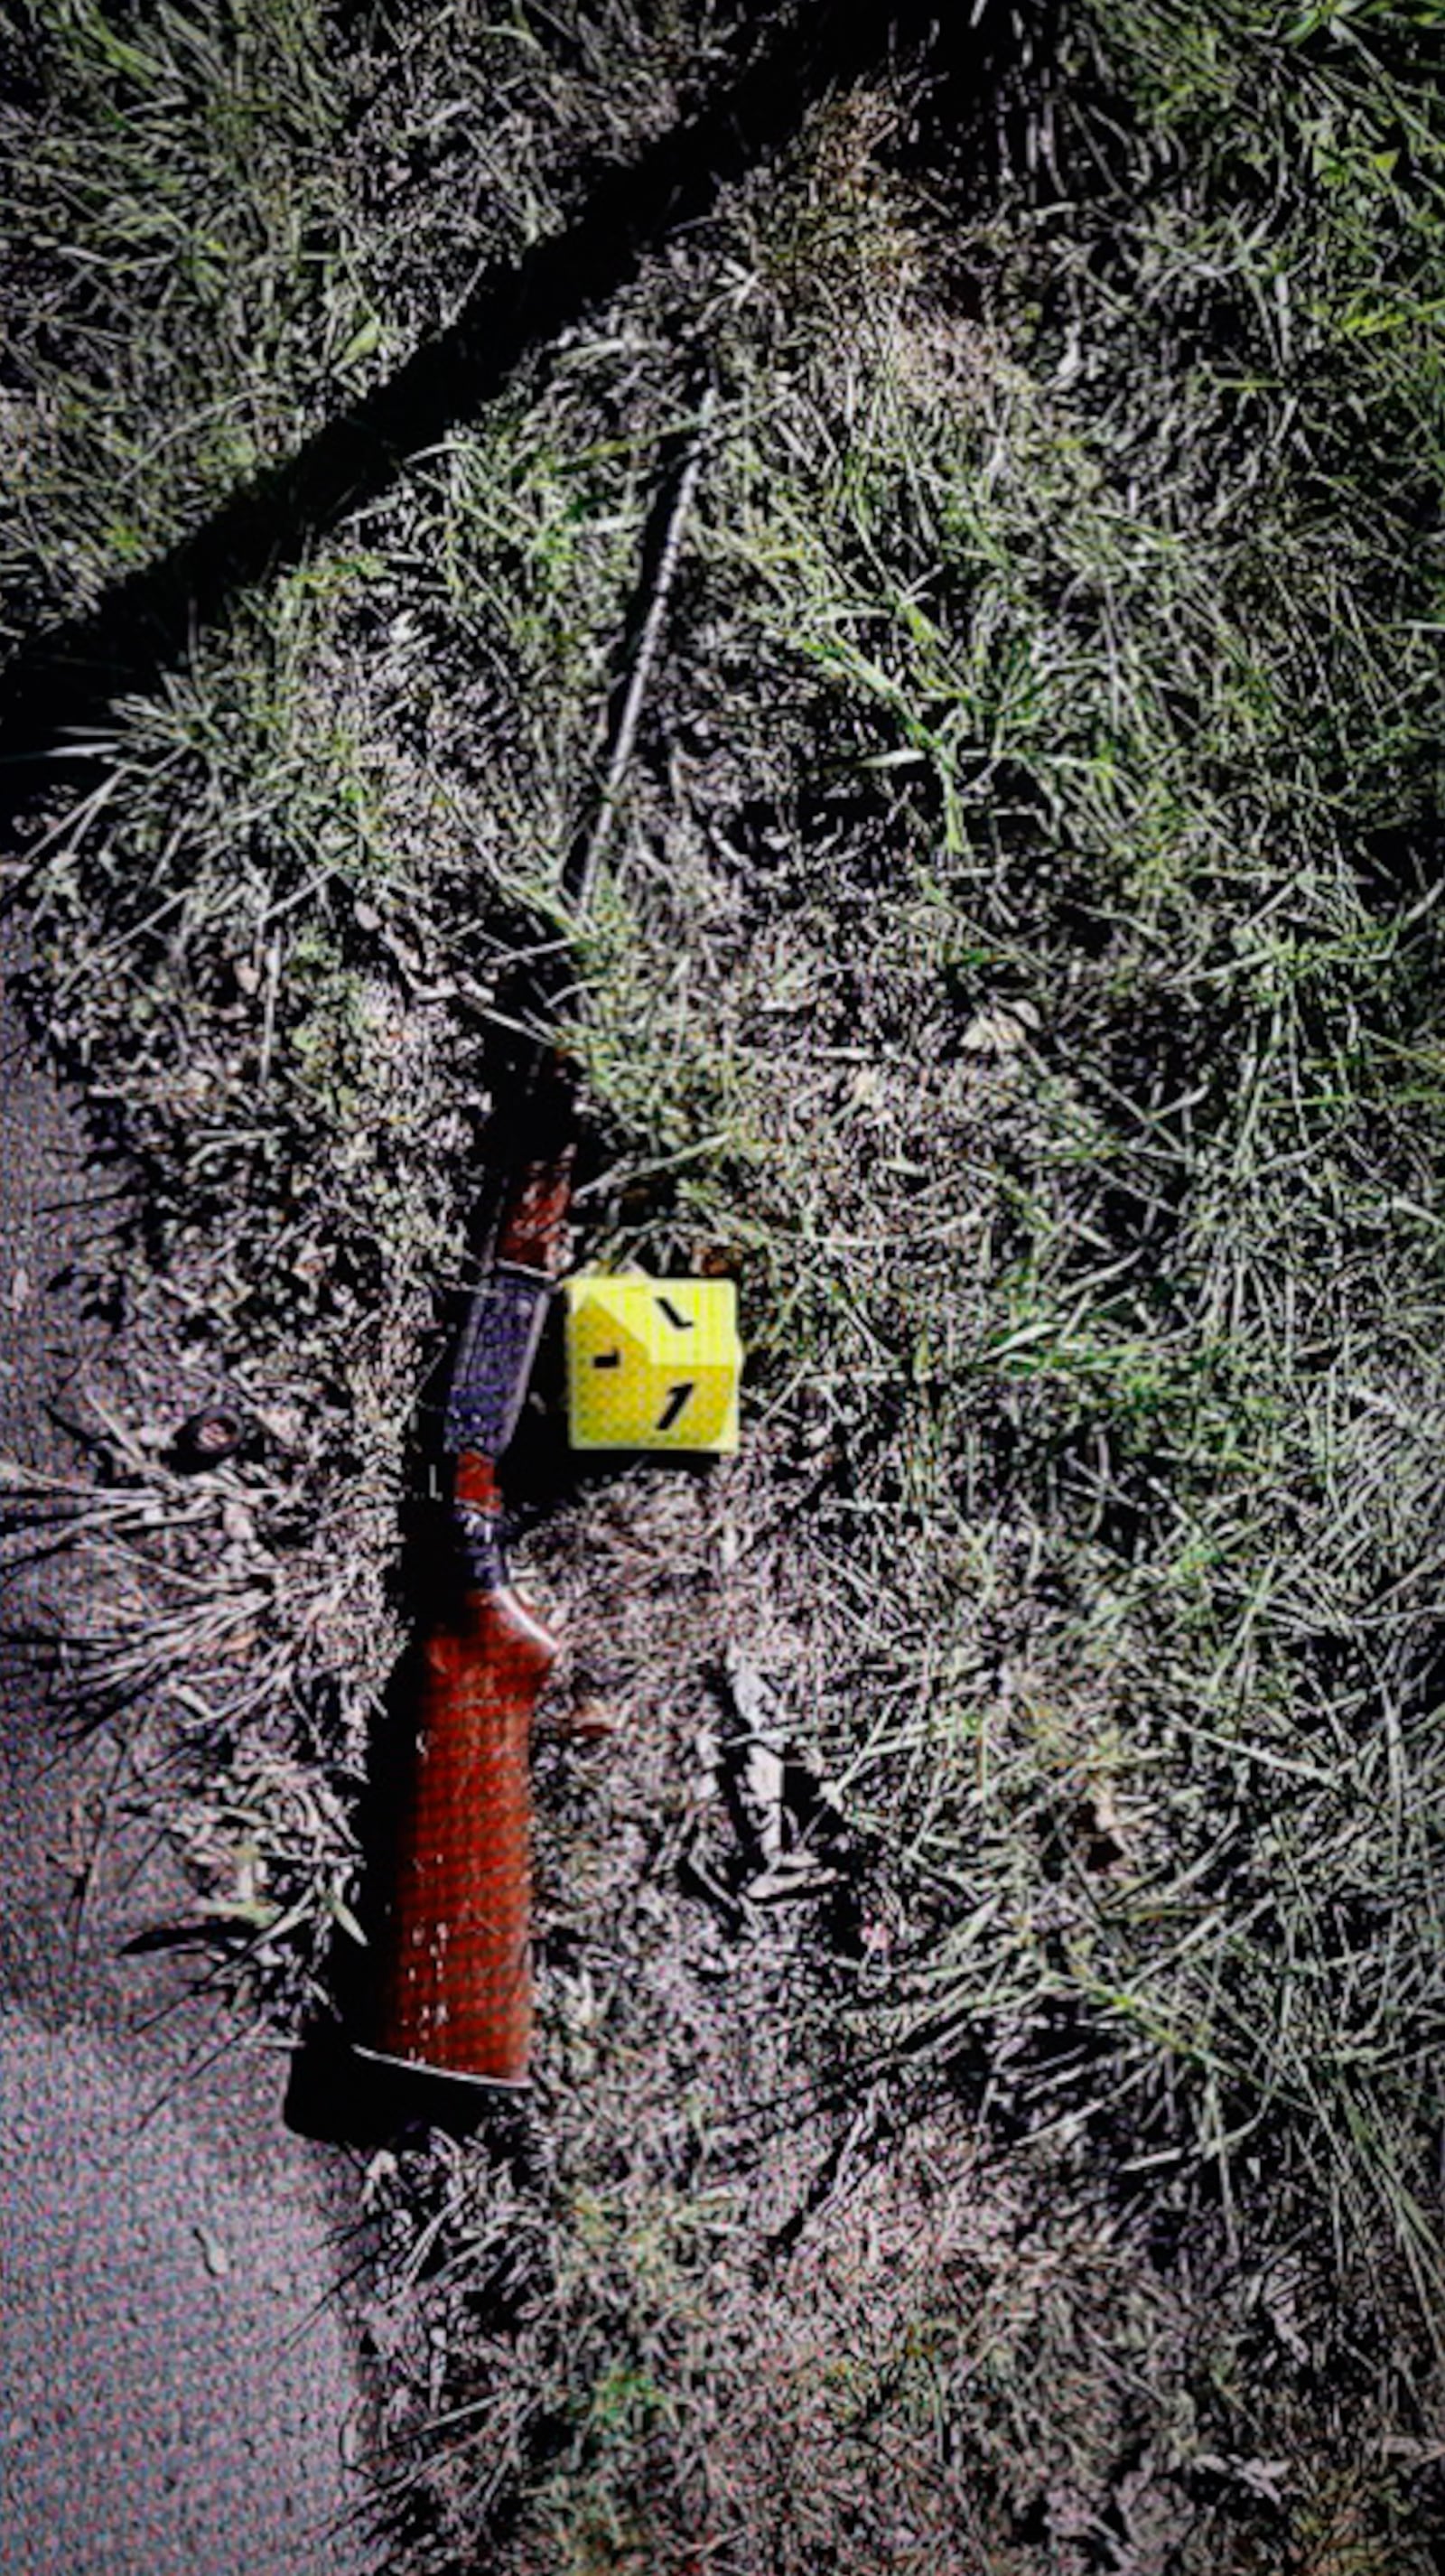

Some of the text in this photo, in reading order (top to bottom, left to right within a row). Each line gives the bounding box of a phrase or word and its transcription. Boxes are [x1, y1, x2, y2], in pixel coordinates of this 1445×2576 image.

[655, 1297, 694, 1329] 1
[592, 1350, 620, 1368] 1
[656, 1383, 694, 1431] 1
